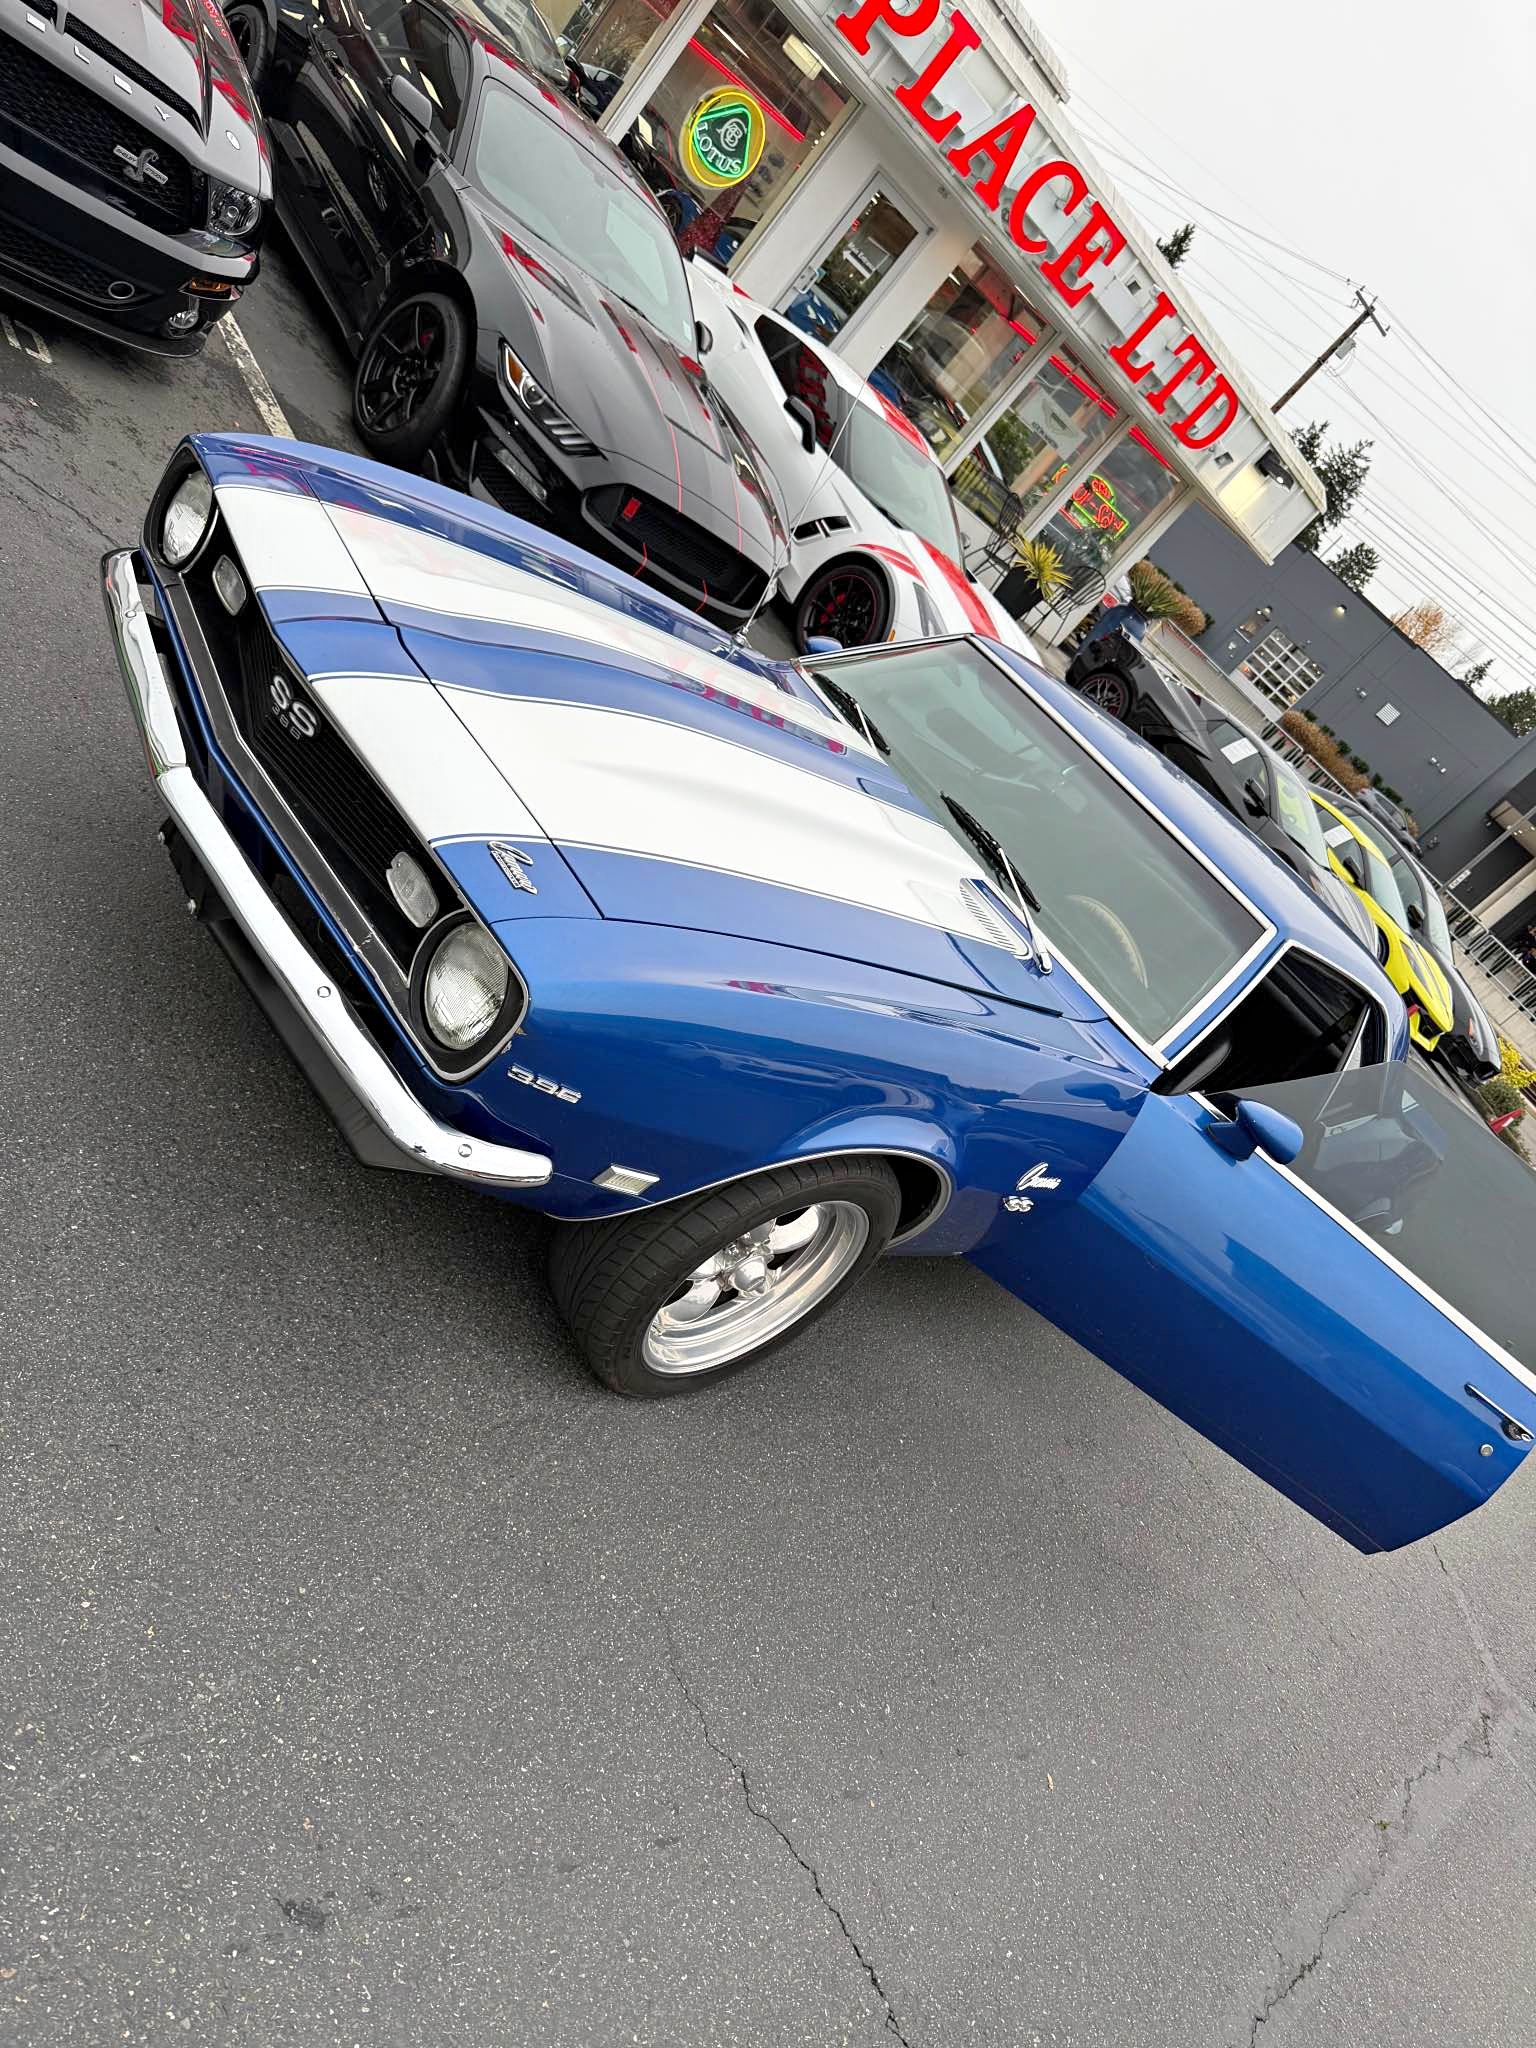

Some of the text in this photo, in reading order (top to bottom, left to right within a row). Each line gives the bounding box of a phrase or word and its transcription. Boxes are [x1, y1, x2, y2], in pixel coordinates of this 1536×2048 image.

[694, 121, 742, 176] LOTUS
[835, 0, 1239, 450] PLACE LTD
[268, 674, 320, 739] SS
[507, 1063, 583, 1105] 396
[1002, 1194, 1035, 1214] SS
